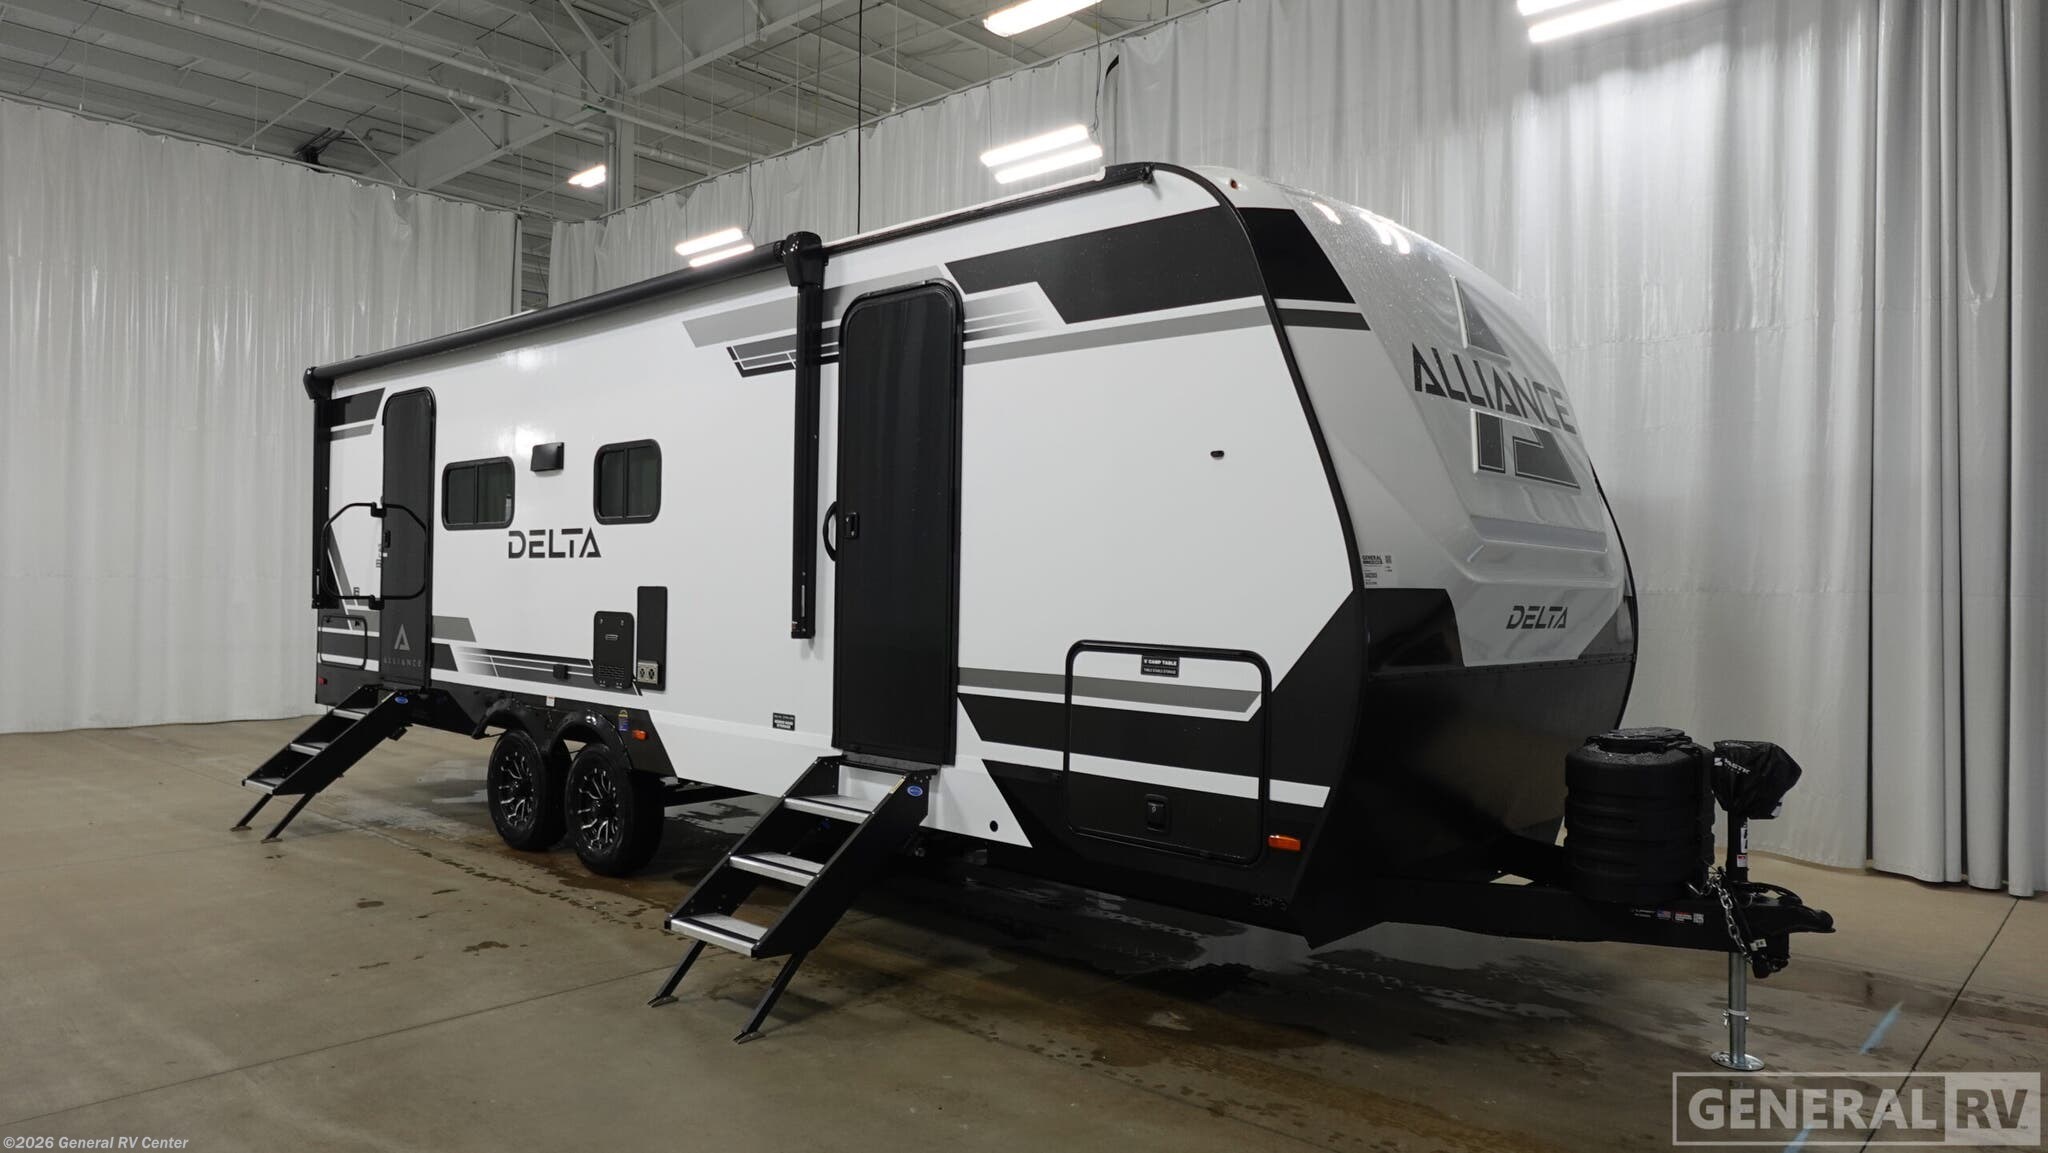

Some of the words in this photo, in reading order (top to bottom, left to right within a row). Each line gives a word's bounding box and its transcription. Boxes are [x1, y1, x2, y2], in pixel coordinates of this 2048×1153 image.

[1412, 342, 1577, 435] ALLIANCE
[508, 527, 602, 559] DELTA
[1506, 605, 1568, 630] DELTA
